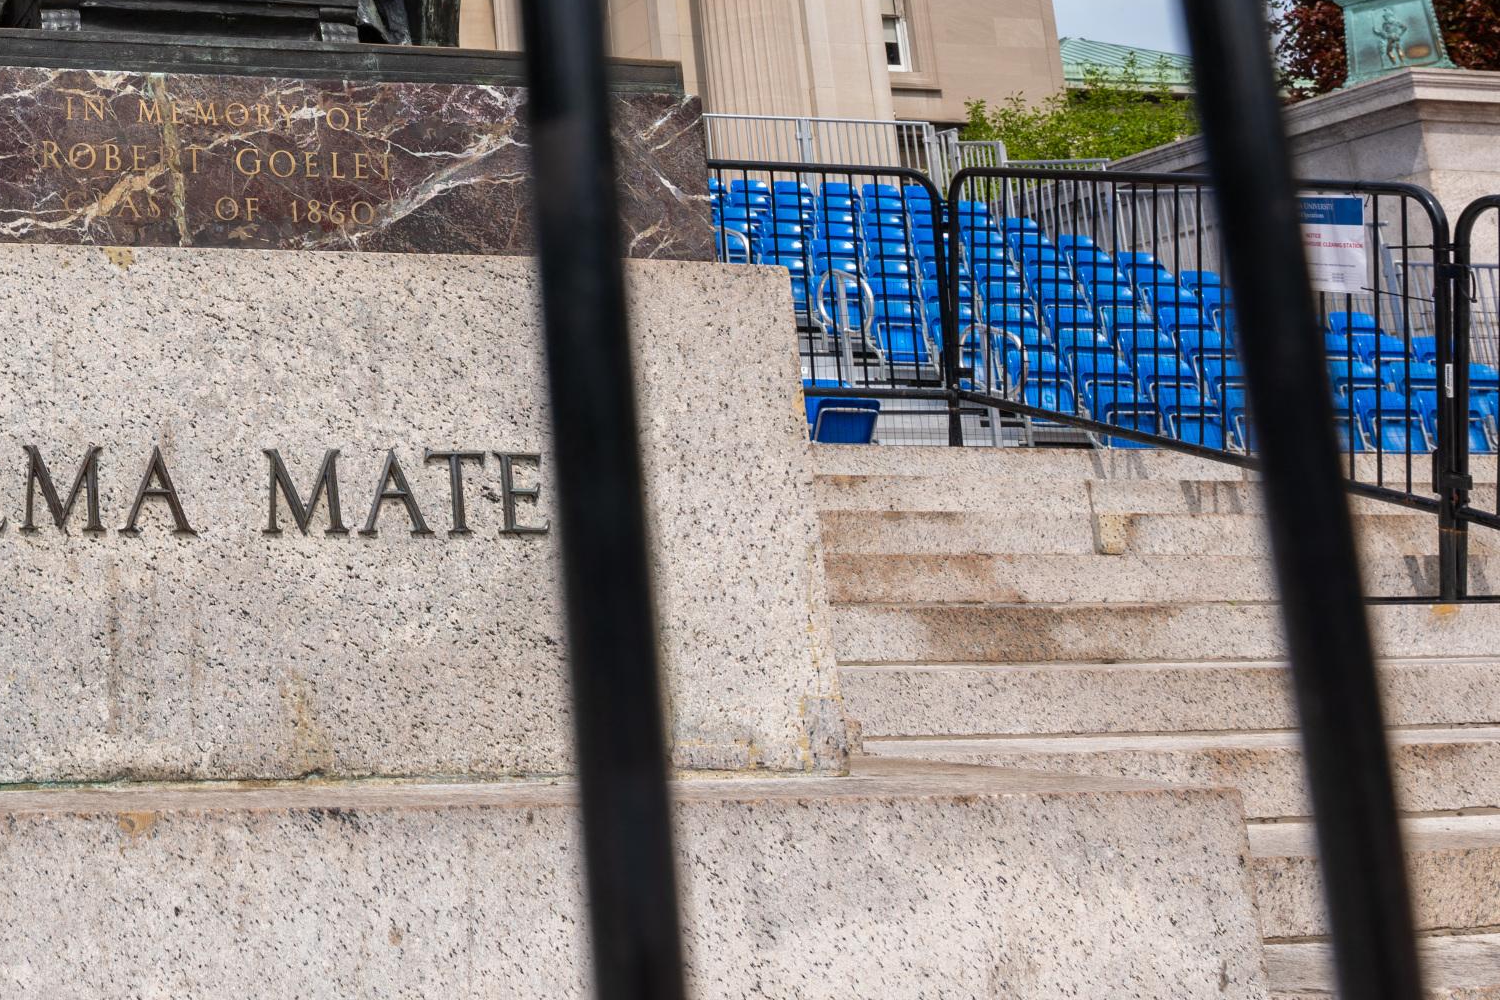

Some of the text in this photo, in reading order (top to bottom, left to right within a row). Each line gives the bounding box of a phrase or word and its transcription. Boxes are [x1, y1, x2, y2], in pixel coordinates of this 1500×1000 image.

[65, 96, 370, 131] IN MEMORY OF
[41, 141, 205, 175] ROBERT
[214, 195, 260, 222] OF
[290, 198, 376, 226] 1860
[261, 447, 551, 536] MATE
